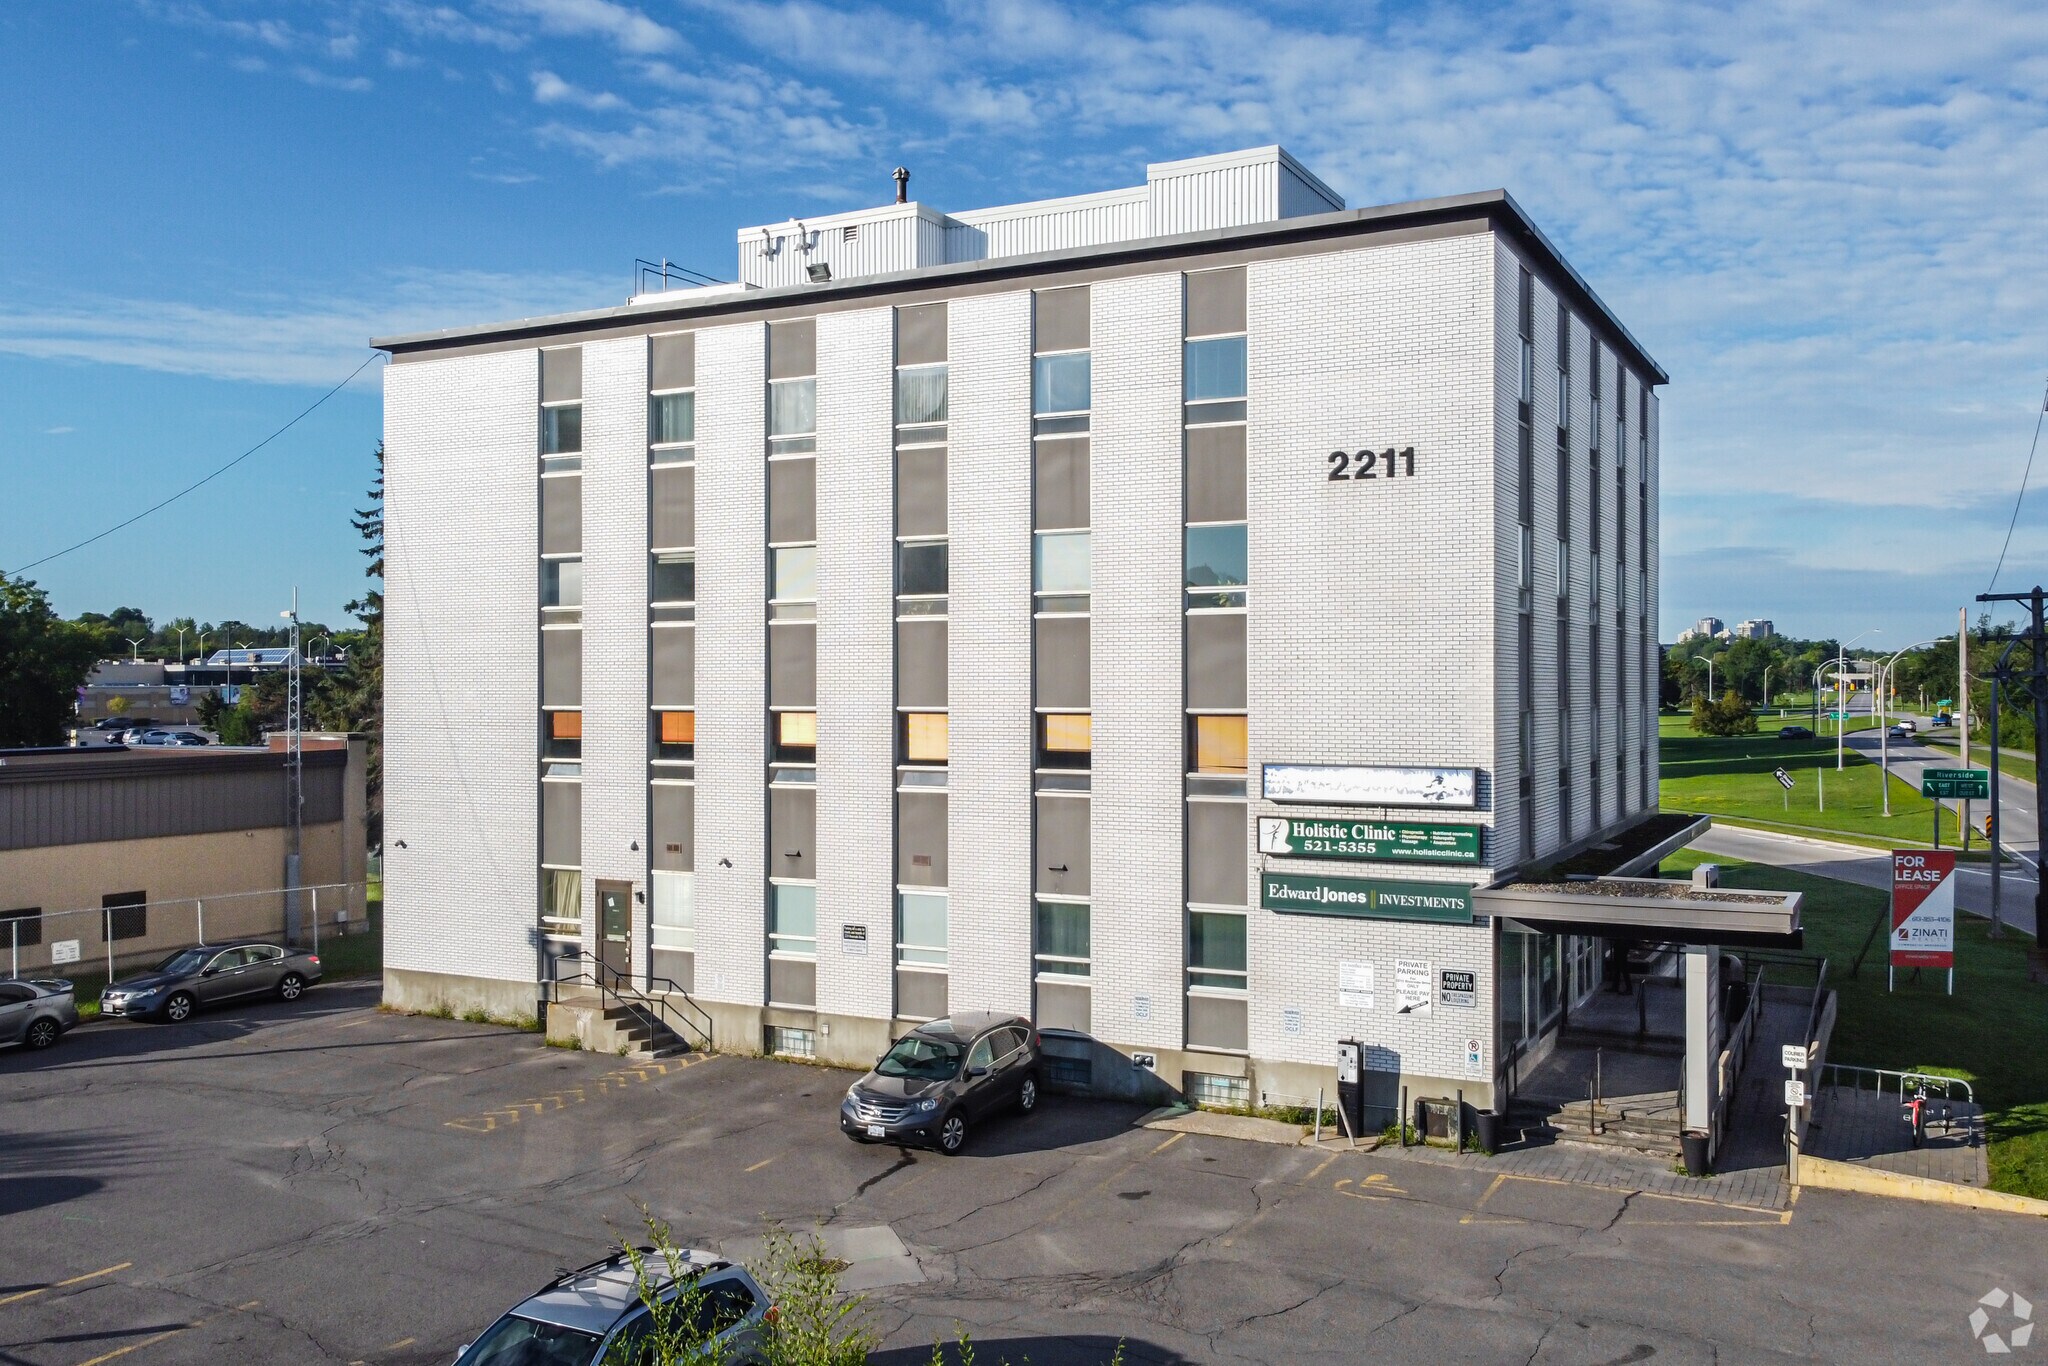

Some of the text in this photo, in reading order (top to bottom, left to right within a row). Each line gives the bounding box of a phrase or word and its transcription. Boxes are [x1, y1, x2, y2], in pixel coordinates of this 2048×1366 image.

[1328, 447, 1414, 481] 2211
[1936, 771, 1974, 779] Riverside
[1292, 822, 1396, 840] Holistic Clinic
[1304, 840, 1376, 853] 521-5355
[1391, 848, 1475, 858] www.holisticclinic.ca
[1895, 855, 1925, 867] FOR
[1895, 869, 1941, 881] LEASE
[1379, 893, 1465, 910] INVESTMENTS
[1912, 928, 1948, 937] ZINATI
[1398, 961, 1428, 969] PRIVATE
[1397, 968, 1429, 976] PARKING
[1445, 973, 1470, 982] PRIVATE
[1443, 981, 1473, 990] PROPERTY
[1441, 992, 1451, 1002] NO
